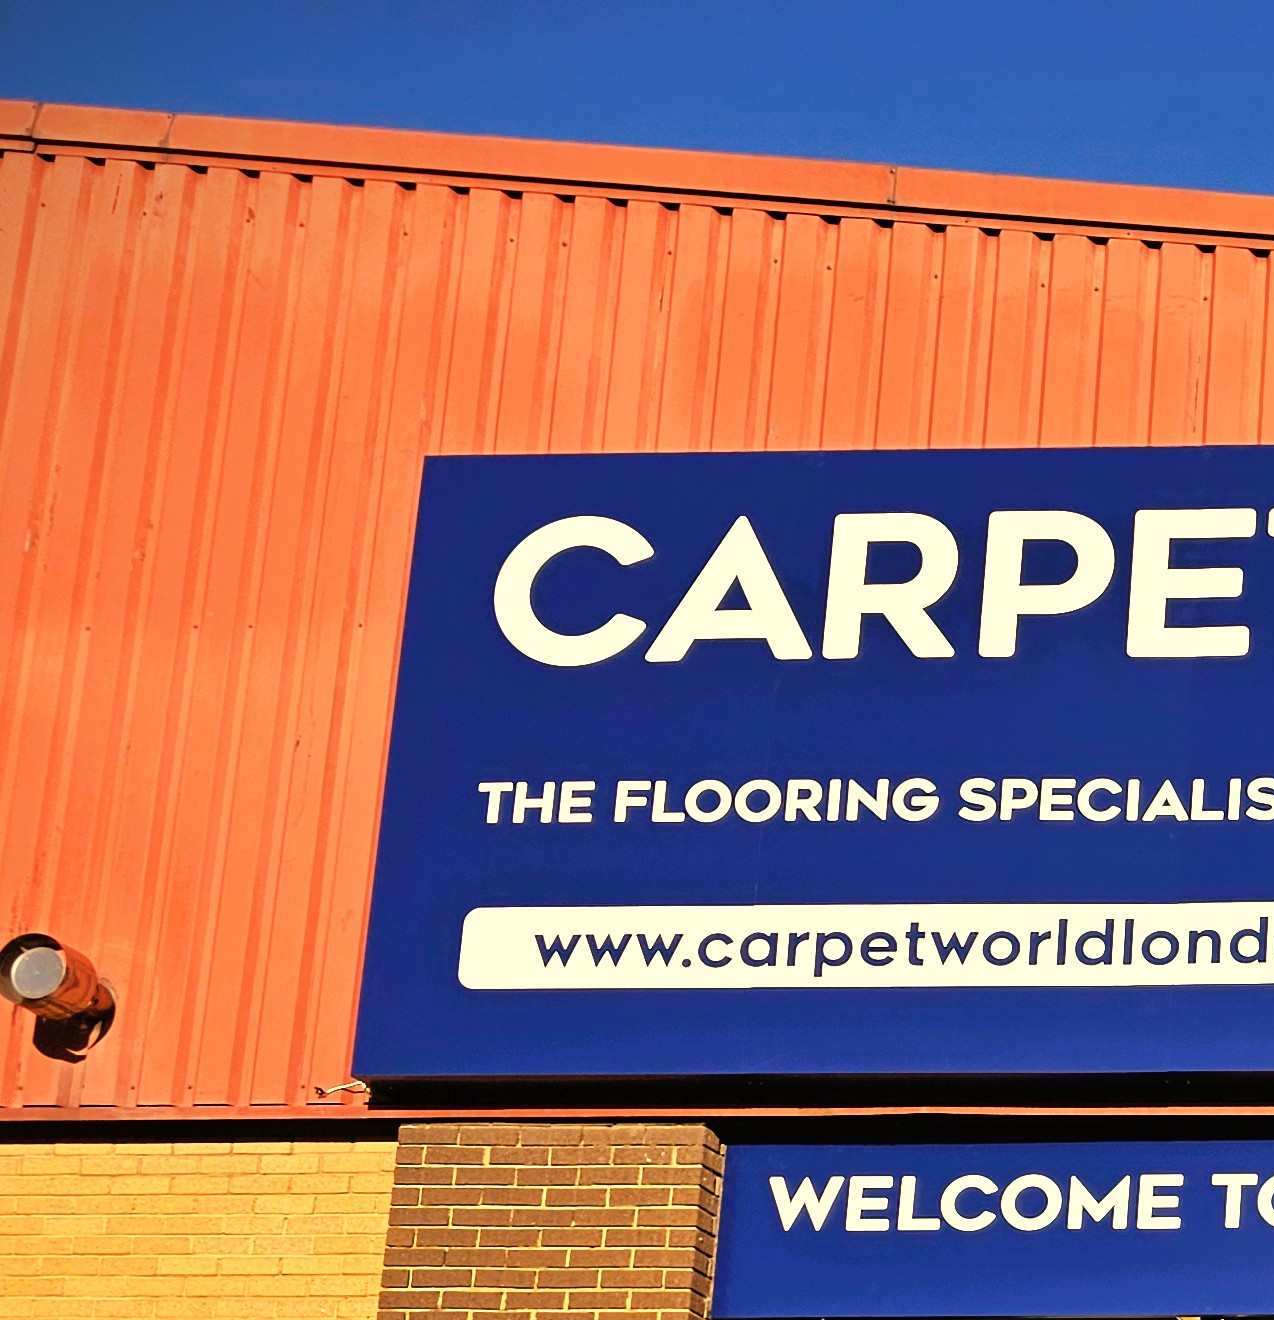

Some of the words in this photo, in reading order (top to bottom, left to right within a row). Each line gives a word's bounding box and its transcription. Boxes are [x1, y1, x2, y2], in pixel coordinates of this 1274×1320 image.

[477, 779, 596, 824] THE
[613, 777, 940, 823] FLOORING
[769, 1173, 1185, 1232] WELCOME
